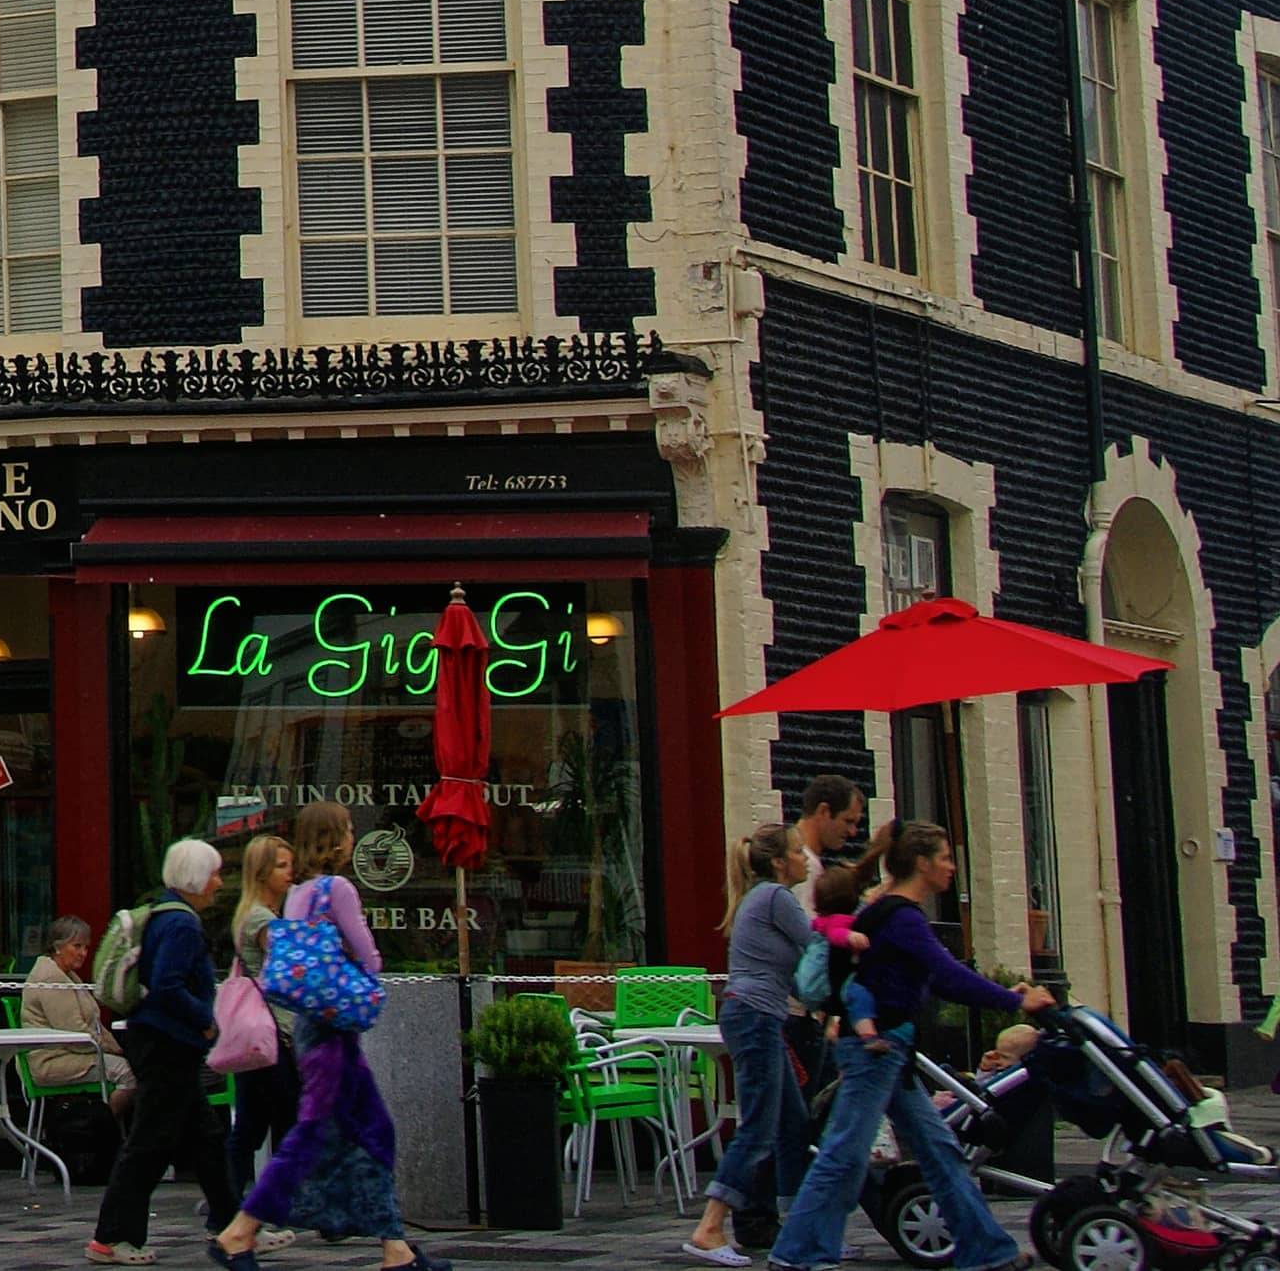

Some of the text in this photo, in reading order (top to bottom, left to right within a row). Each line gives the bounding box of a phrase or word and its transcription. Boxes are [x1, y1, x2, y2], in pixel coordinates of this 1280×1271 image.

[466, 474, 567, 490] Tel: 687753
[187, 591, 577, 697] La GigGi
[231, 784, 289, 807] EAT
[295, 784, 326, 806] IN
[334, 783, 374, 807] OR
[483, 784, 534, 807] UT
[416, 907, 482, 930] BAR
